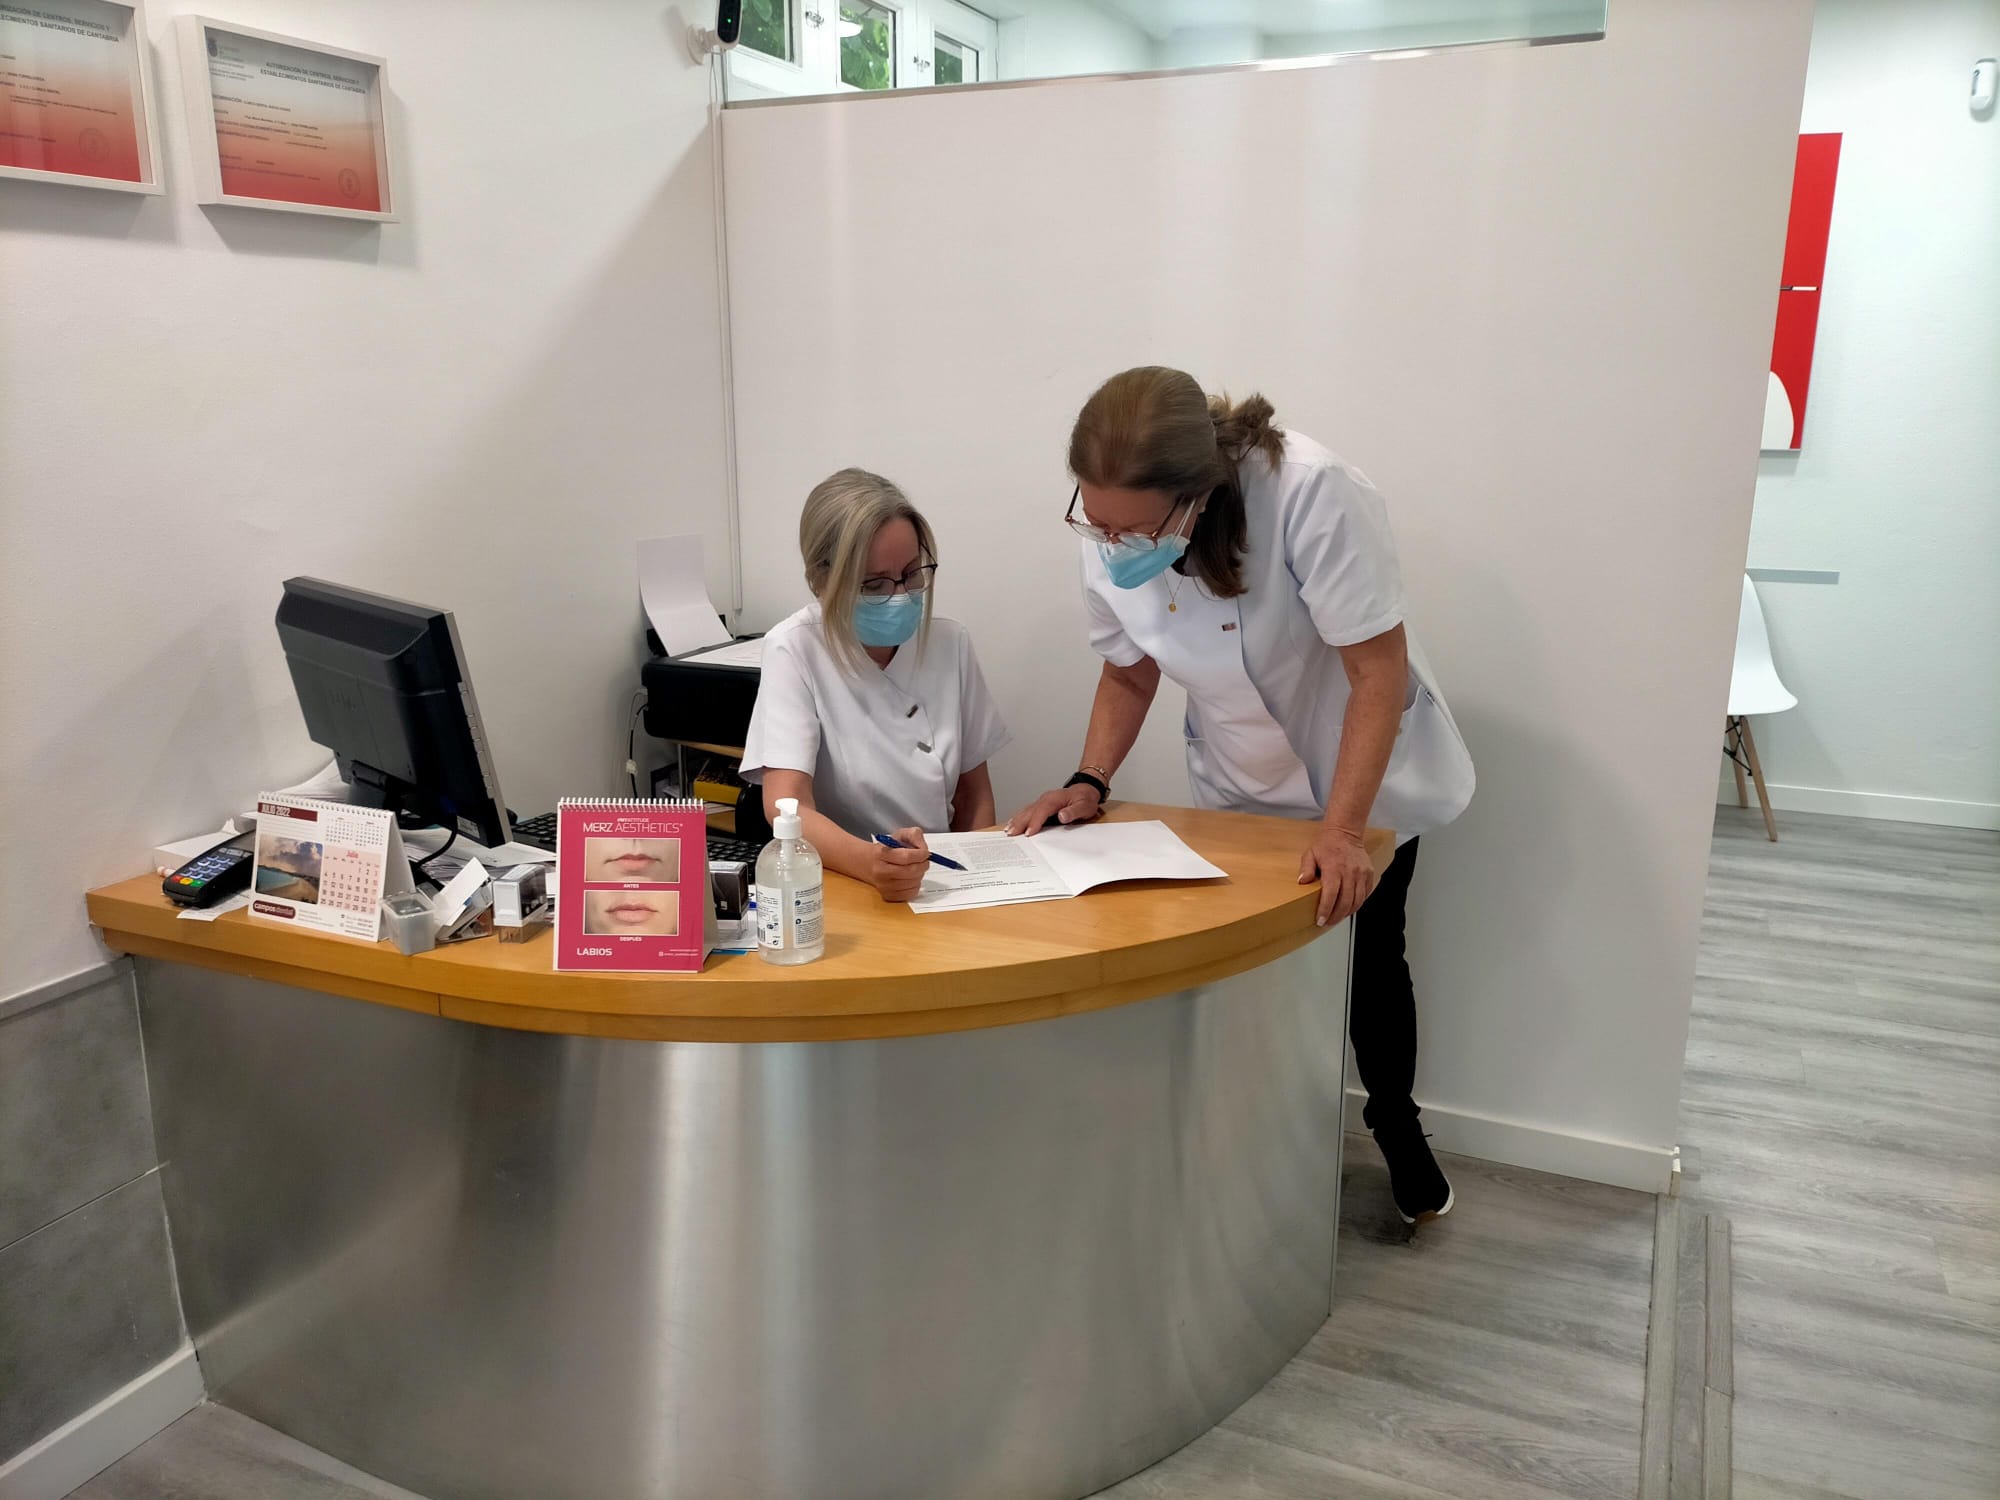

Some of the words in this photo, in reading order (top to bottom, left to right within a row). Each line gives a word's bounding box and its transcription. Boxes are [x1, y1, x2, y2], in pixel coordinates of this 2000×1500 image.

[77, 28, 85, 36] DE
[261, 803, 276, 815] JULIO
[276, 806, 290, 817] 2022
[583, 822, 614, 833] MERZ
[576, 947, 613, 956] LABIOS
